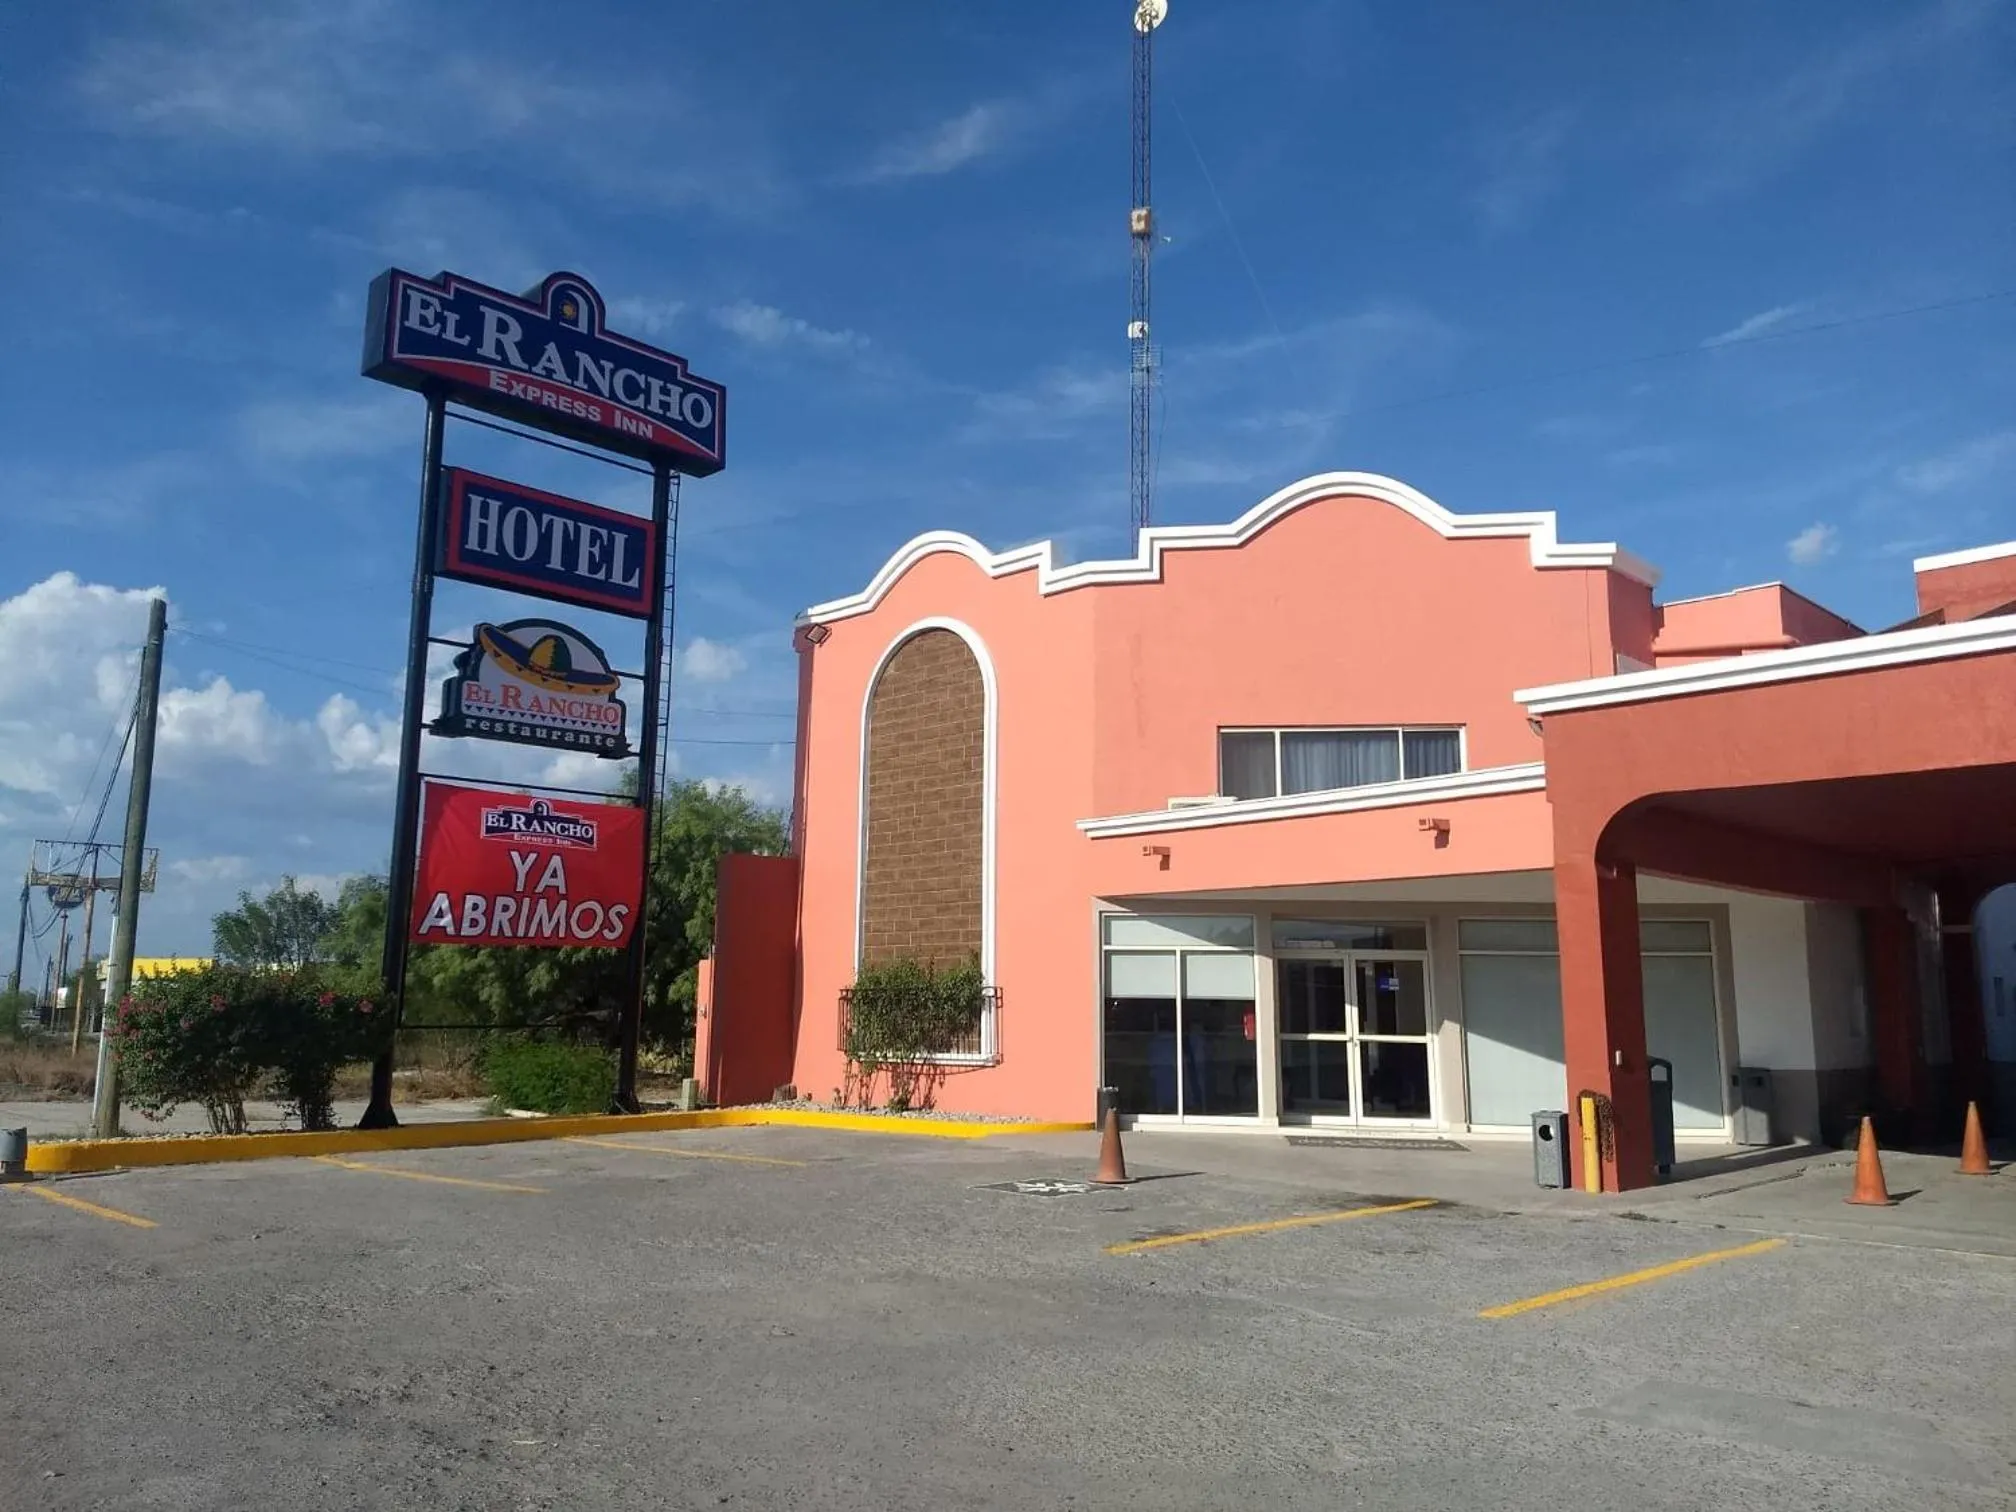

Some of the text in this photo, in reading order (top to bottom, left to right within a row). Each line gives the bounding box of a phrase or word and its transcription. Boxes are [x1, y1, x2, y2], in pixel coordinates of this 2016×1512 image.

[404, 289, 712, 429] EL RANCHO
[464, 493, 640, 589] HOTEL
[466, 683, 619, 724] EL RANCHO
[464, 717, 616, 748] restaurante
[486, 812, 594, 838] EL RANCHO
[510, 850, 567, 894] YA
[418, 892, 629, 940] ABRIMOS
